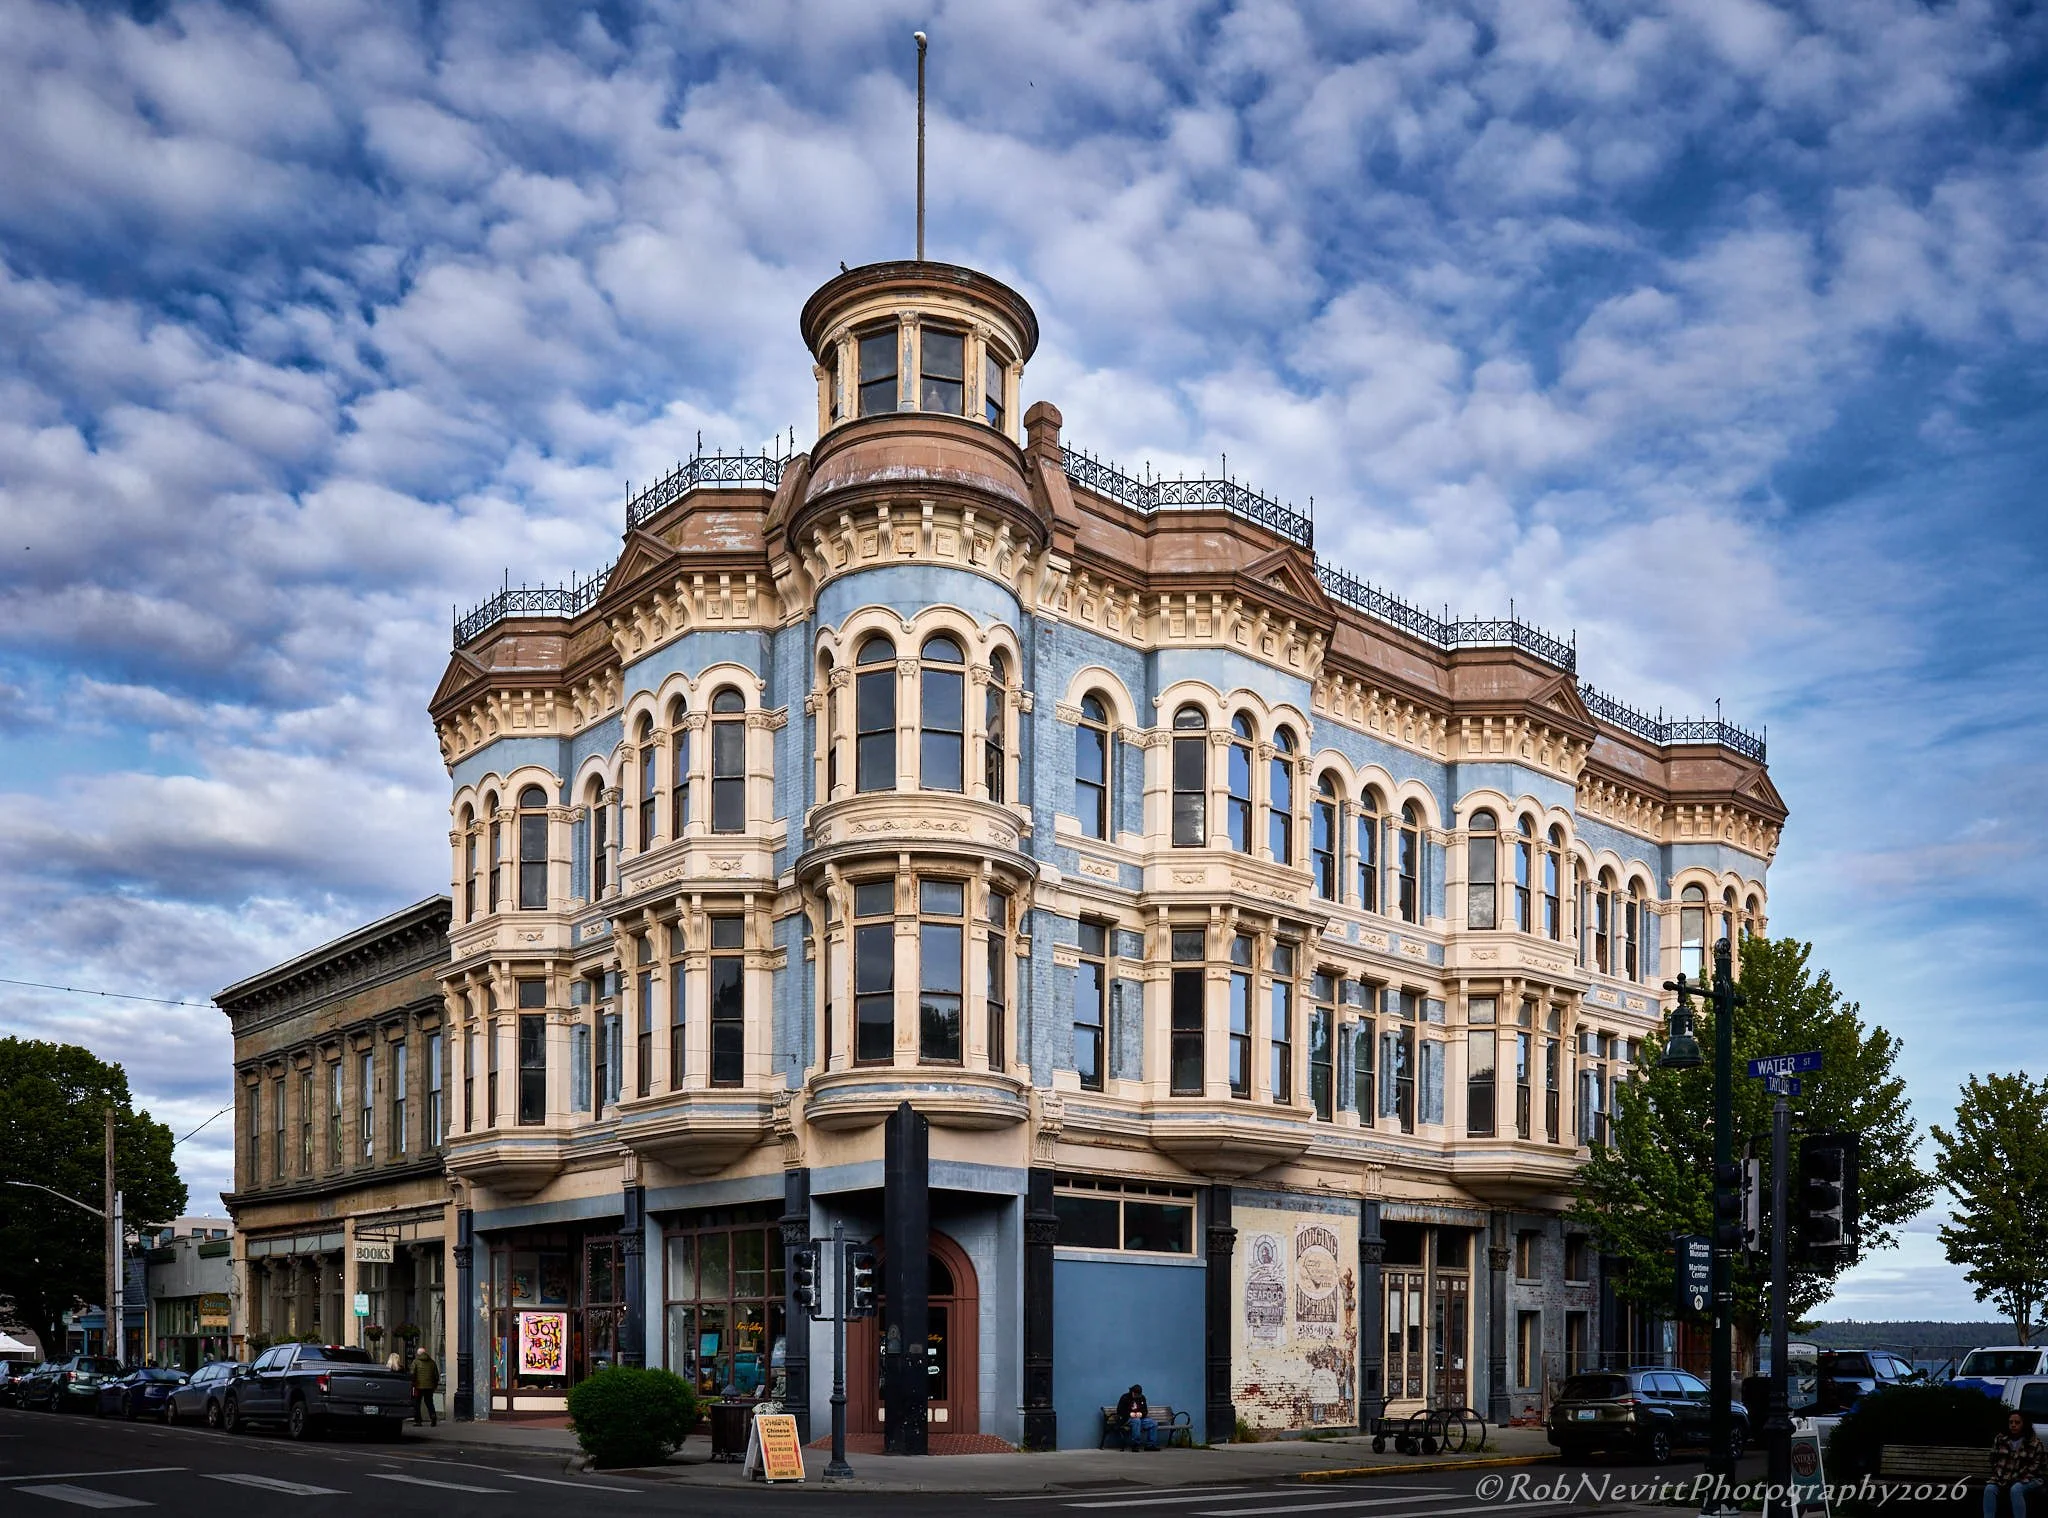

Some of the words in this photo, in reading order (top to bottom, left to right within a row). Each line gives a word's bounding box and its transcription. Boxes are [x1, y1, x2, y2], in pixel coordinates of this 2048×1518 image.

[1757, 1057, 1795, 1075] WATER
[1803, 1057, 1811, 1066] ST
[1769, 1077, 1790, 1092] TAYLOR
[1297, 1229, 1337, 1258] LODGING
[1689, 1242, 1710, 1251] Jefferson
[356, 1247, 390, 1260] BOOKS
[1689, 1263, 1709, 1271] Maritime
[1692, 1271, 1707, 1279] Center
[1690, 1285, 1699, 1294] City
[1247, 1291, 1284, 1301] SEAFOOD
